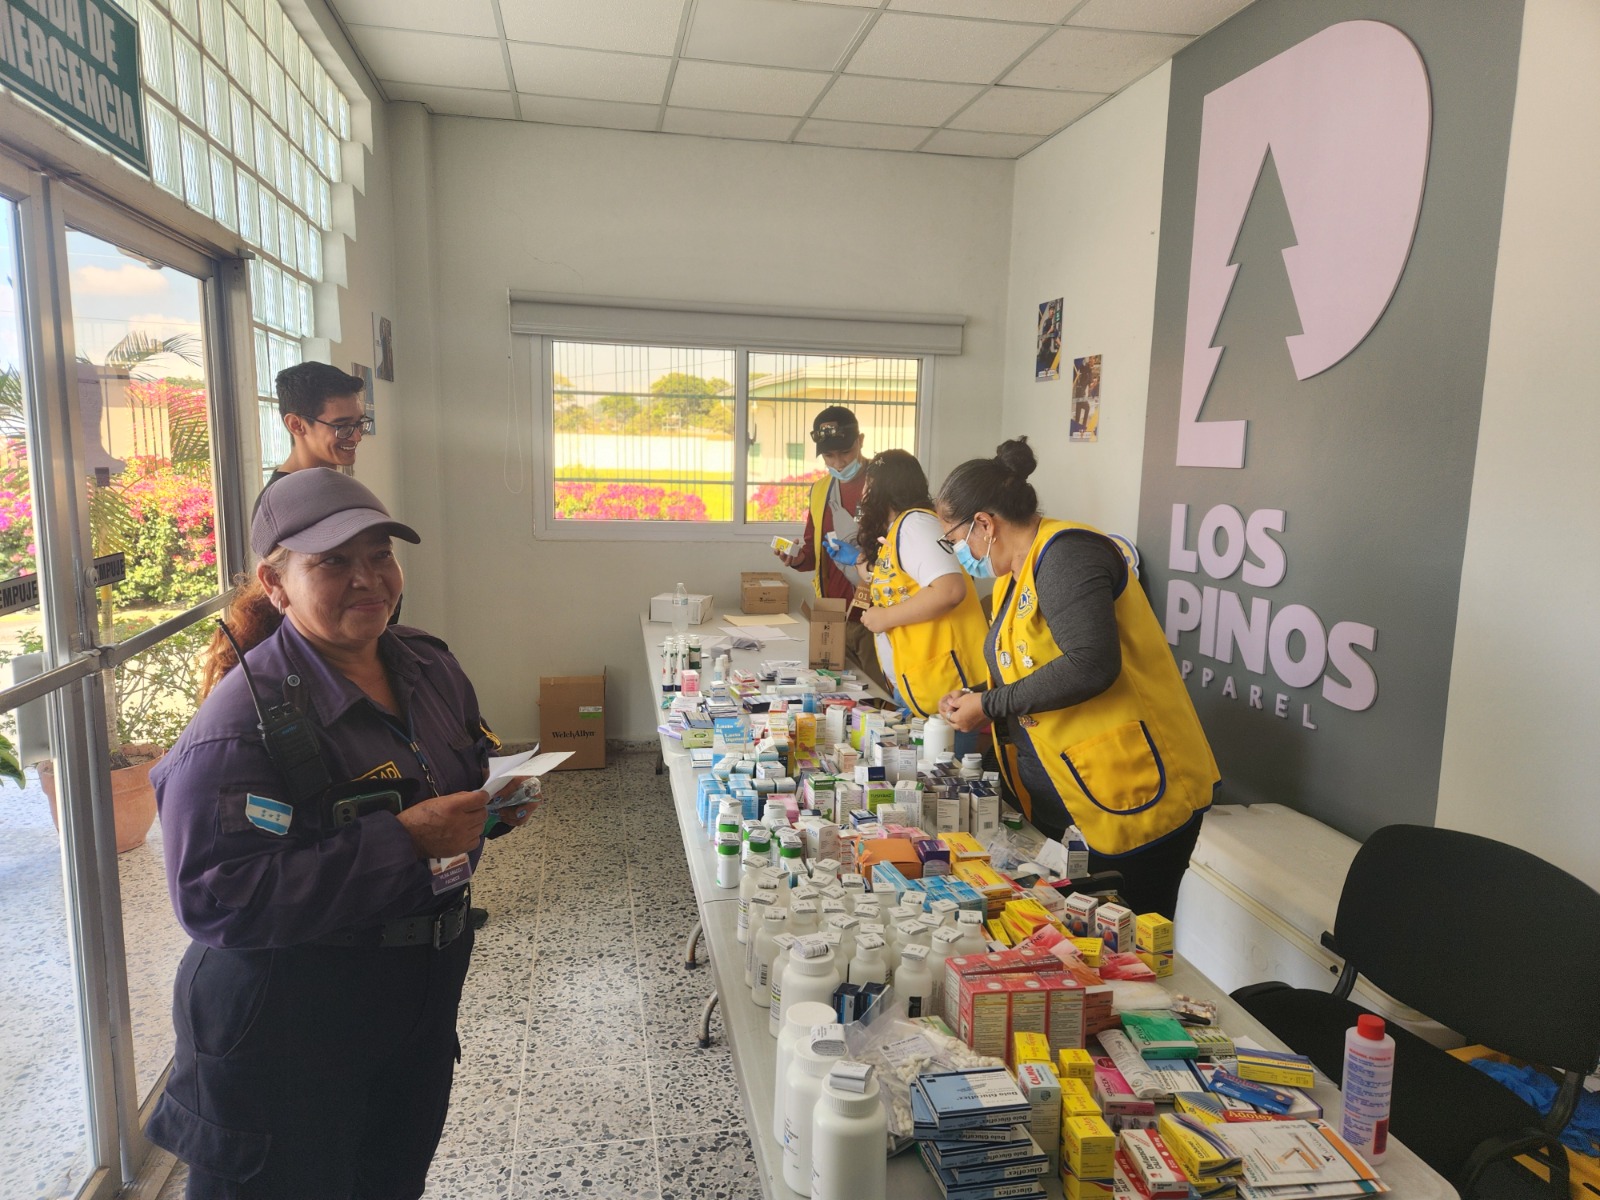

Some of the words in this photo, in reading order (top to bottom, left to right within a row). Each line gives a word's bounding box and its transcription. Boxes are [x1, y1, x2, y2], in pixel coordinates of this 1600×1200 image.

[86, 0, 118, 75] DE
[0, 0, 140, 150] MERGENCIA
[1169, 504, 1287, 587] LOS
[0, 581, 38, 608] MPUJE
[1165, 579, 1378, 711] PINOS
[1181, 660, 1317, 730] PPAREL
[957, 1092, 998, 1101] Glucoflex
[998, 1187, 1033, 1196] Glucoflex
[1007, 1167, 1043, 1176] Glucoflex
